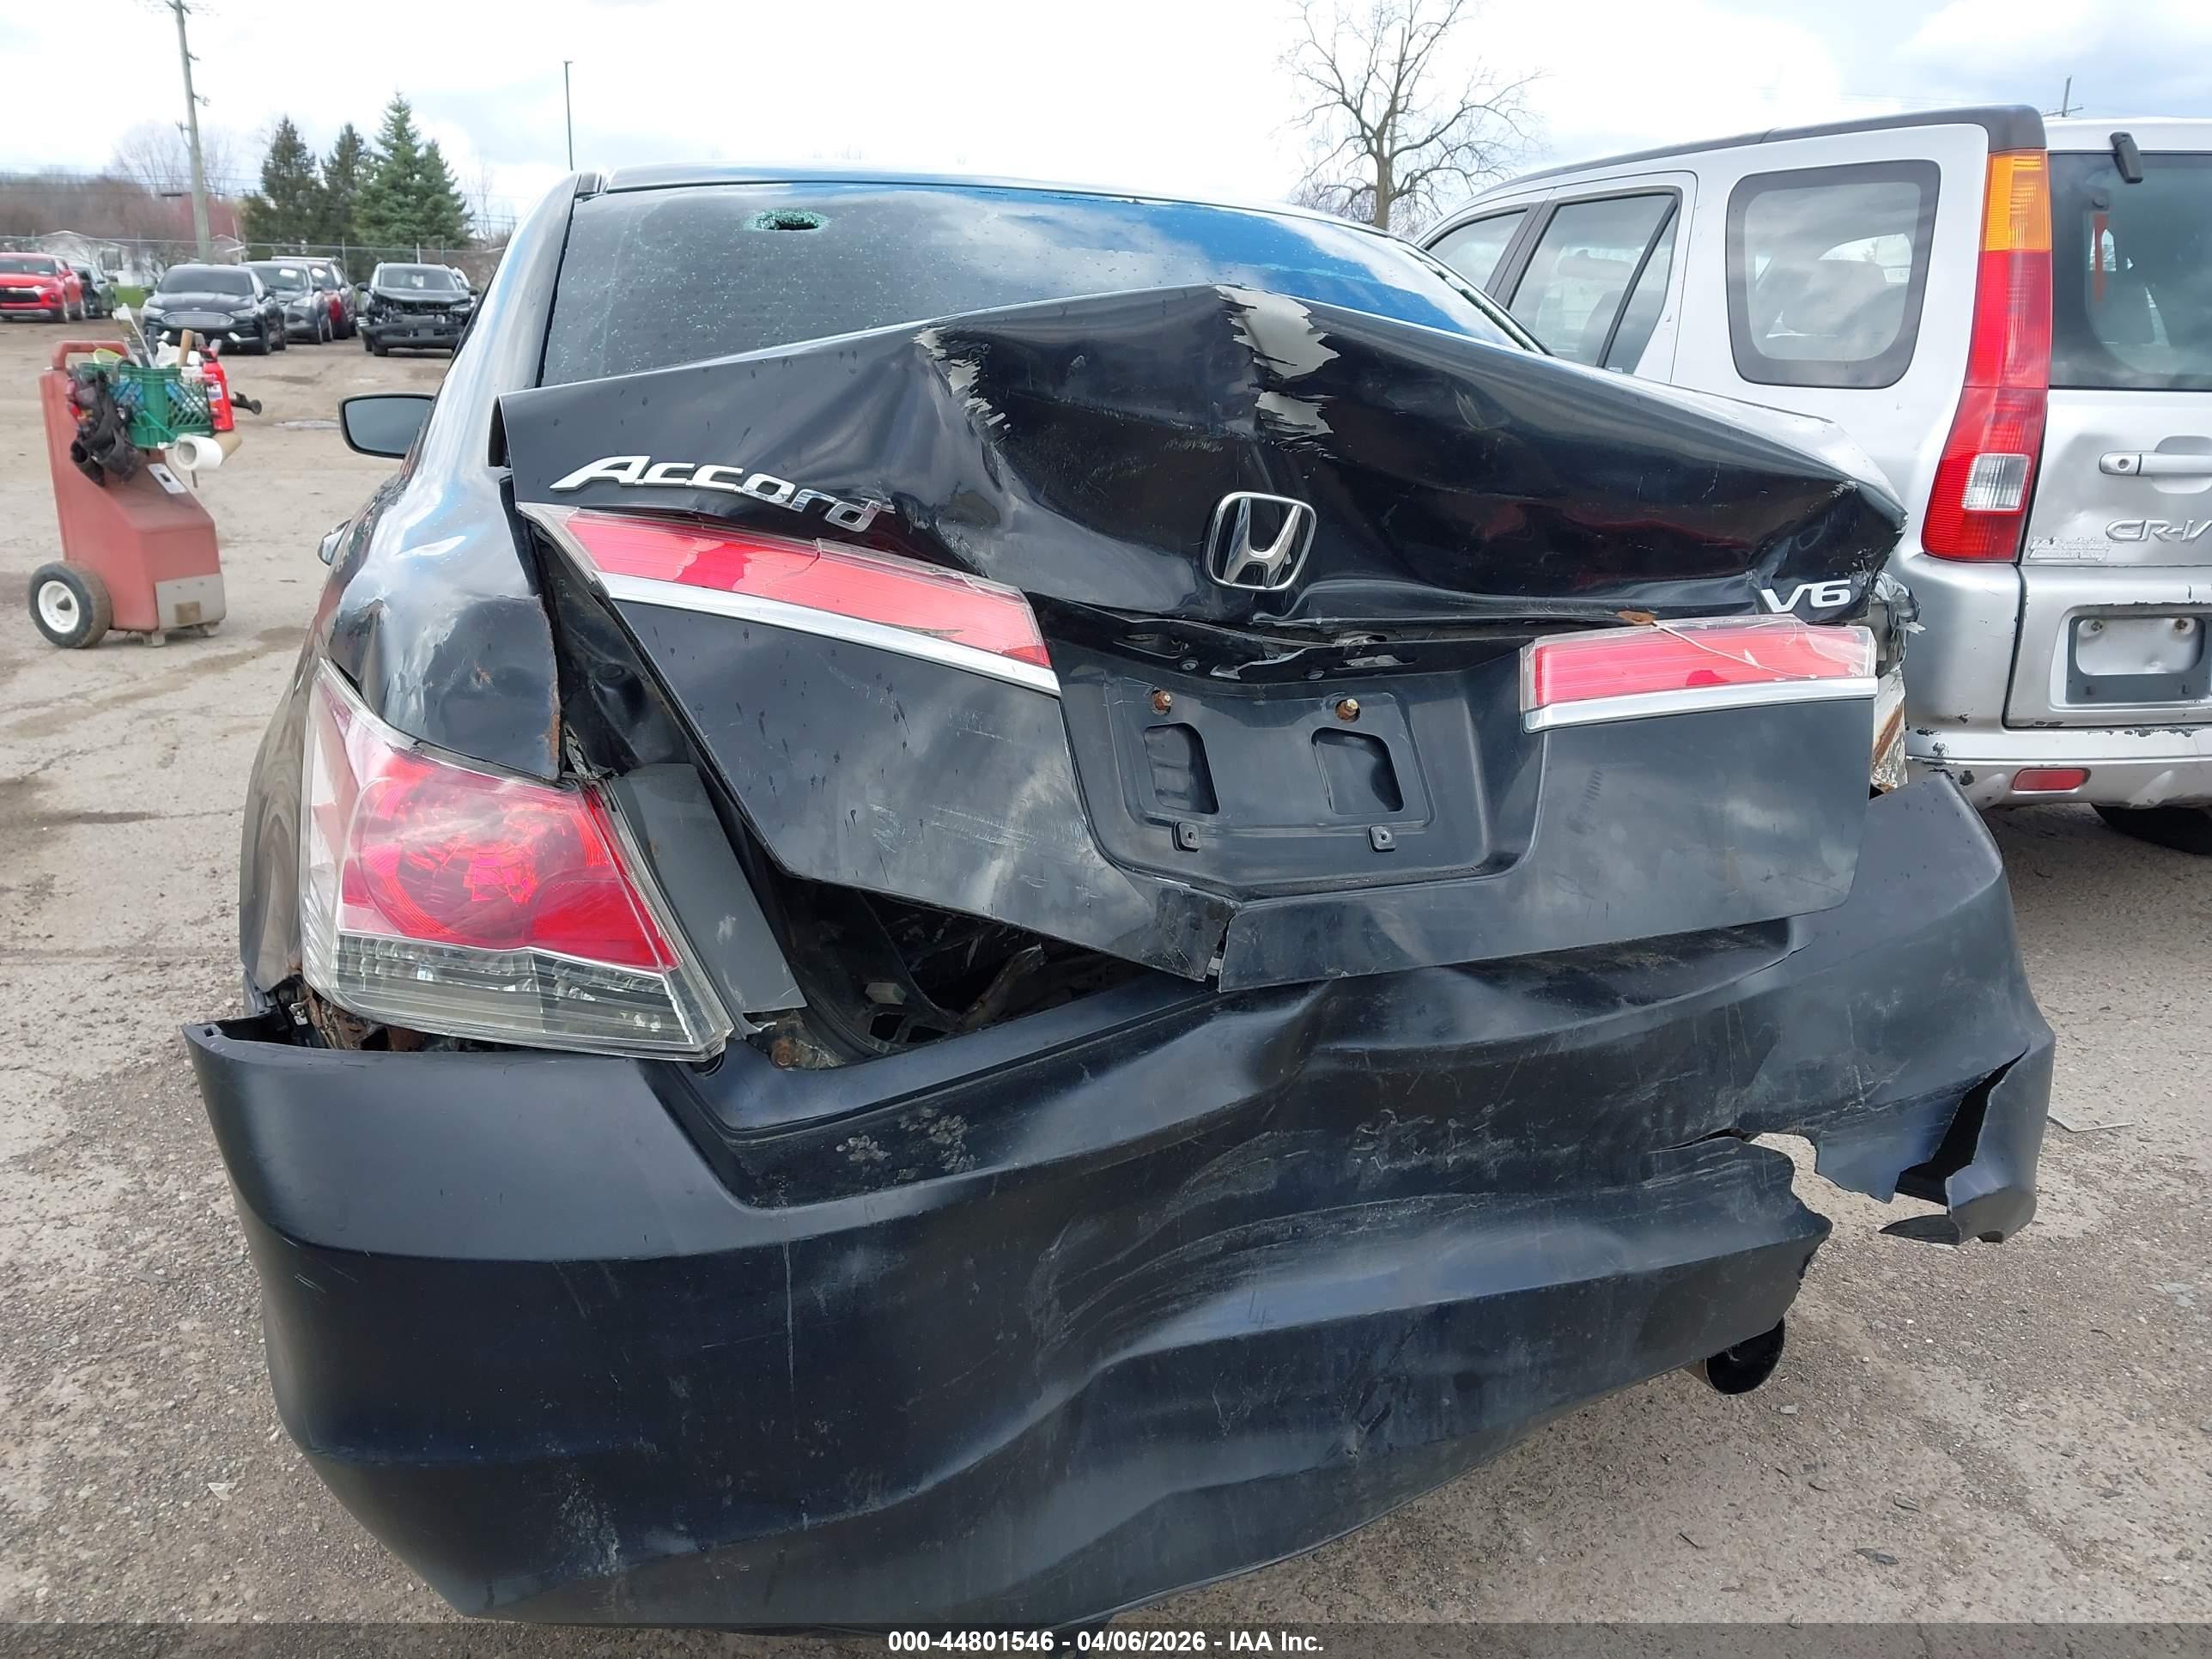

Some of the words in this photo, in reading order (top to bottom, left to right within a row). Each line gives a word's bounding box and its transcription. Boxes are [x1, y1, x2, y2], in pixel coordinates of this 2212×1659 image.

[550, 455, 888, 532] Accord
[2106, 519, 2212, 544] CR-V
[1761, 580, 1851, 613] V6
